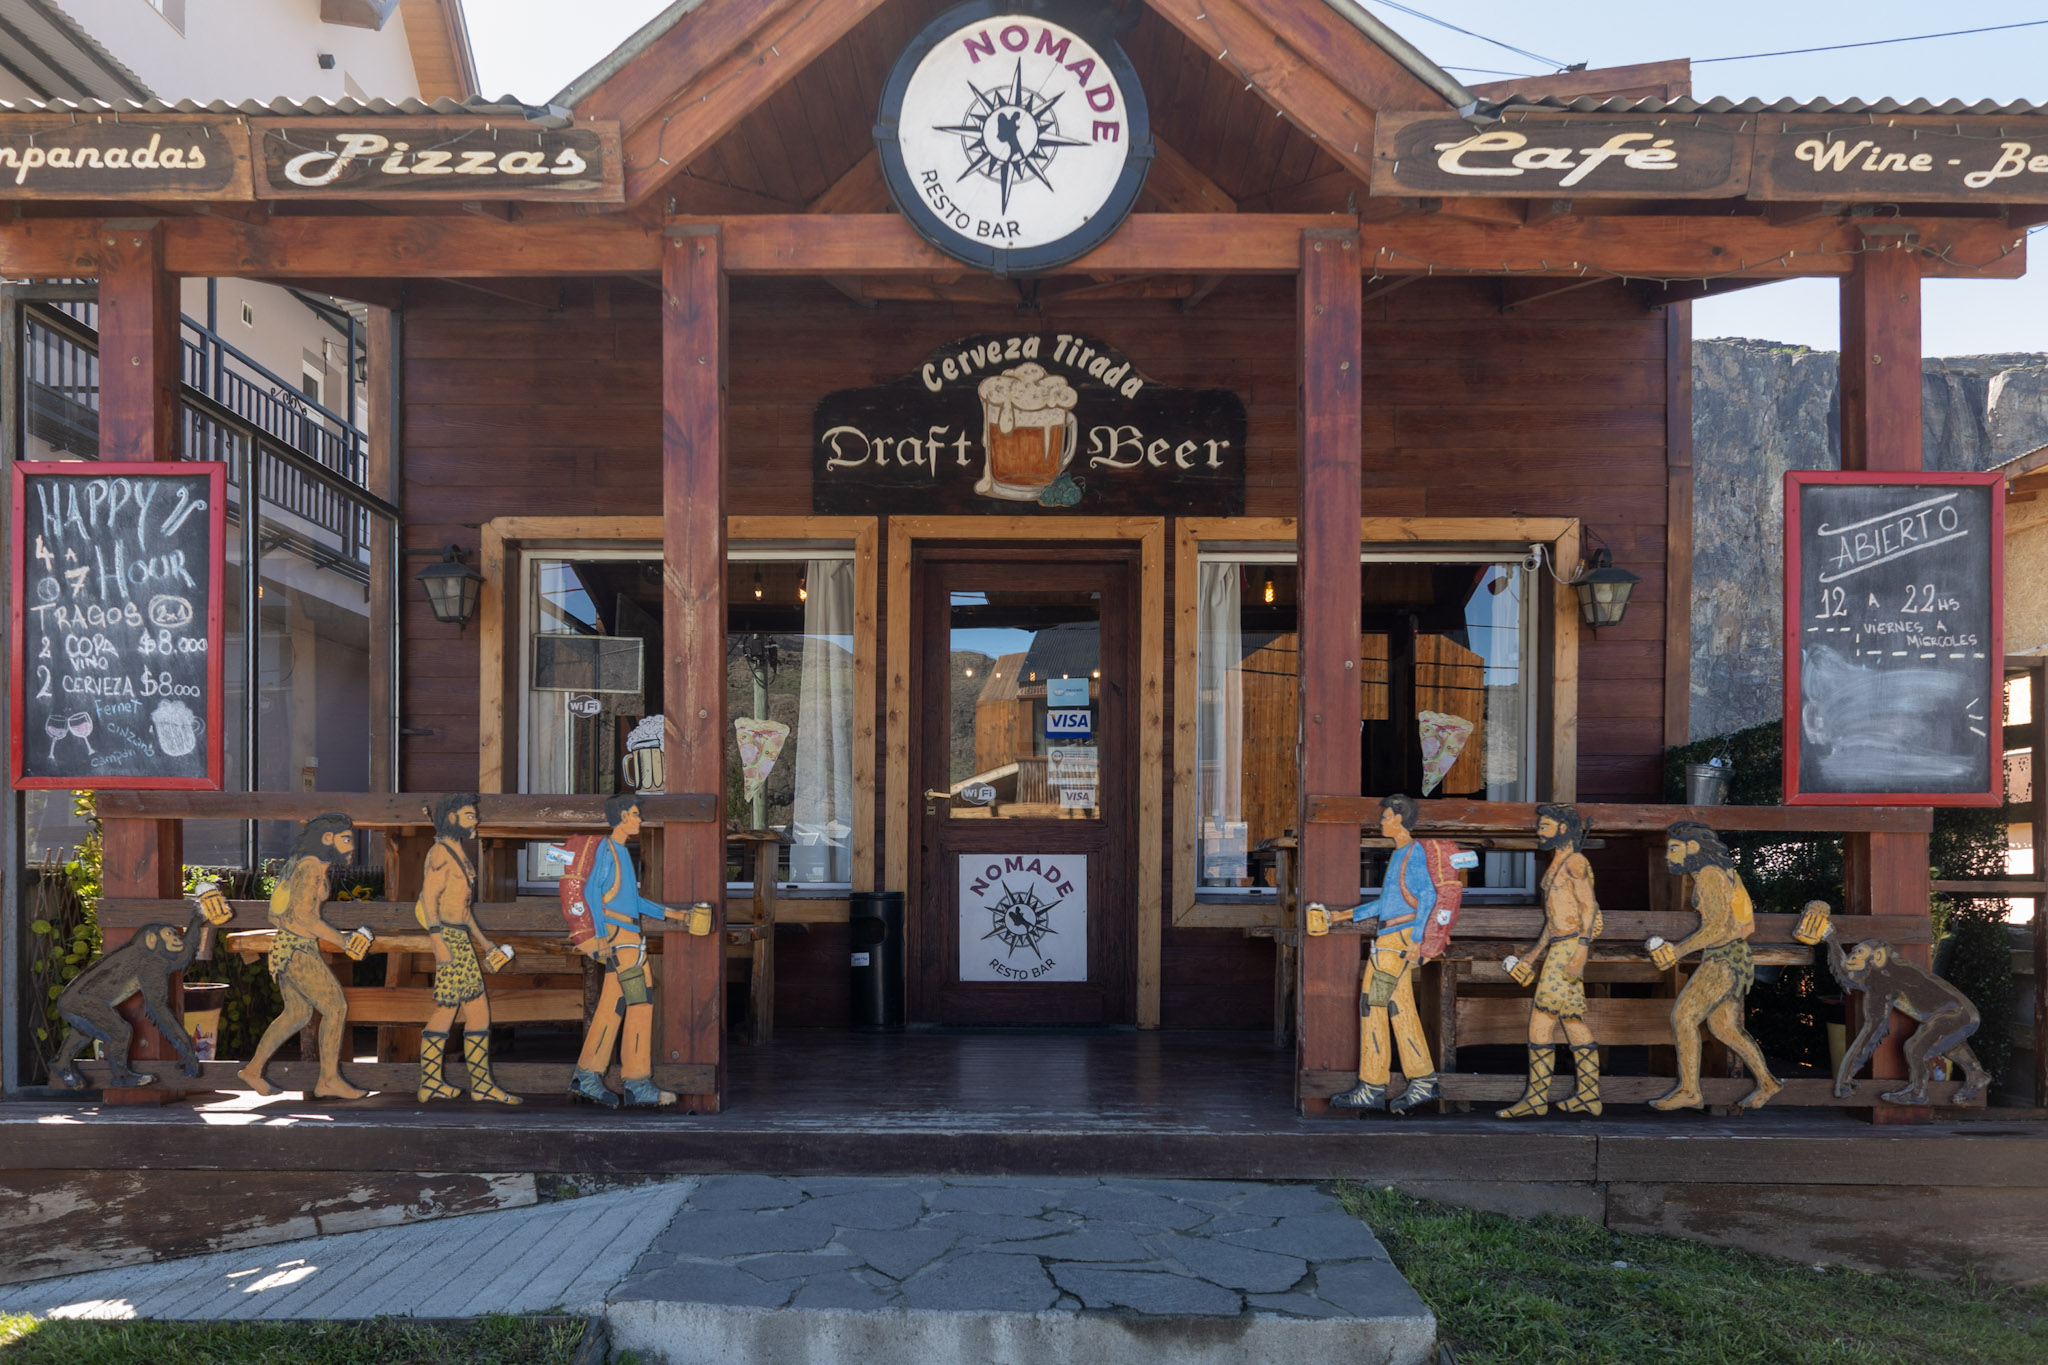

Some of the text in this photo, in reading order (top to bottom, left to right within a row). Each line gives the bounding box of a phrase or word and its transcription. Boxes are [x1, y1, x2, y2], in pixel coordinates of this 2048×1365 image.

[963, 25, 1120, 142] NOMADE
[284, 134, 587, 187] Pizzas
[1434, 131, 1678, 187] Café
[1795, 139, 1933, 172] Wine
[921, 169, 1021, 238] RESTO BAR
[922, 334, 1144, 399] Cerveza Tirada
[821, 425, 1230, 477] Draft Beer
[37, 478, 159, 552] HAPPY
[1829, 505, 1958, 569] ABIERTO
[35, 535, 54, 571] 4
[64, 565, 90, 599] 7
[30, 602, 144, 630] TRAGOS
[1815, 586, 1847, 618] 12
[1868, 592, 1880, 608] A
[38, 627, 208, 658] 2 COPA $8.000
[1936, 620, 1947, 632] A
[36, 664, 200, 698] 2 CERVEZA $8.000
[1051, 714, 1088, 727] VISA
[1066, 792, 1089, 801] VISA
[970, 856, 1074, 898] NOMADE
[989, 958, 1056, 979] RESTO BAR
